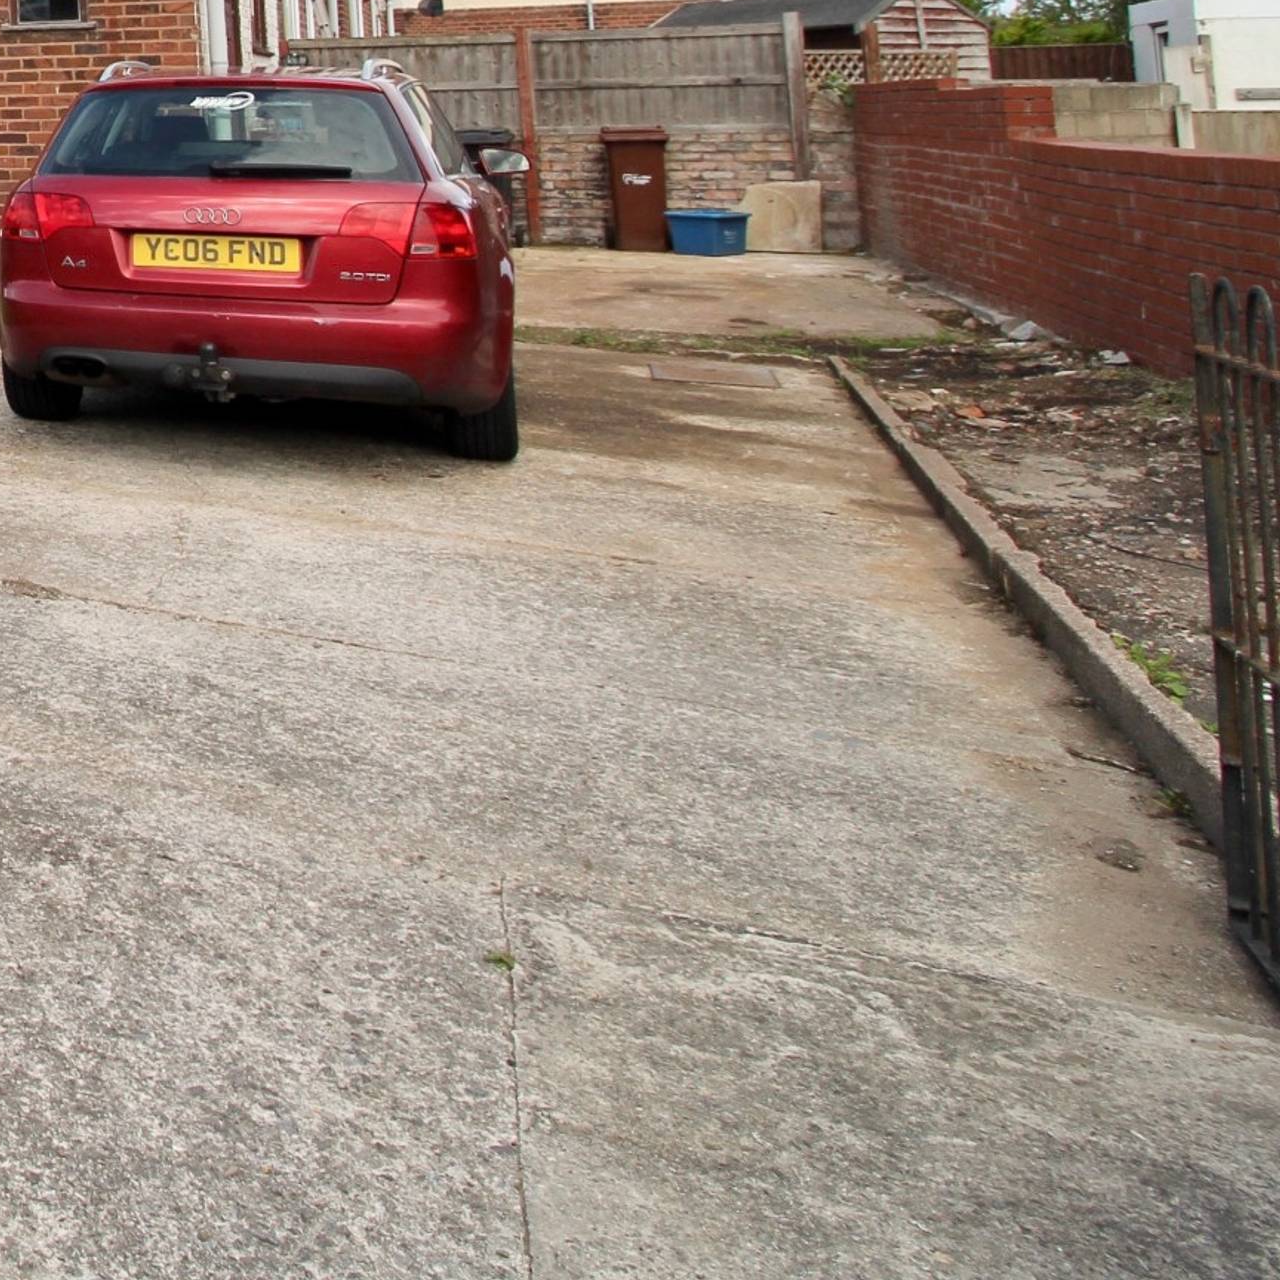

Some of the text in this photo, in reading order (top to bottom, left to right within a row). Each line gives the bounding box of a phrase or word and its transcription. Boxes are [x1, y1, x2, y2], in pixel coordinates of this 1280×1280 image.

[145, 237, 286, 265] YC06 FND
[60, 255, 87, 269] A4
